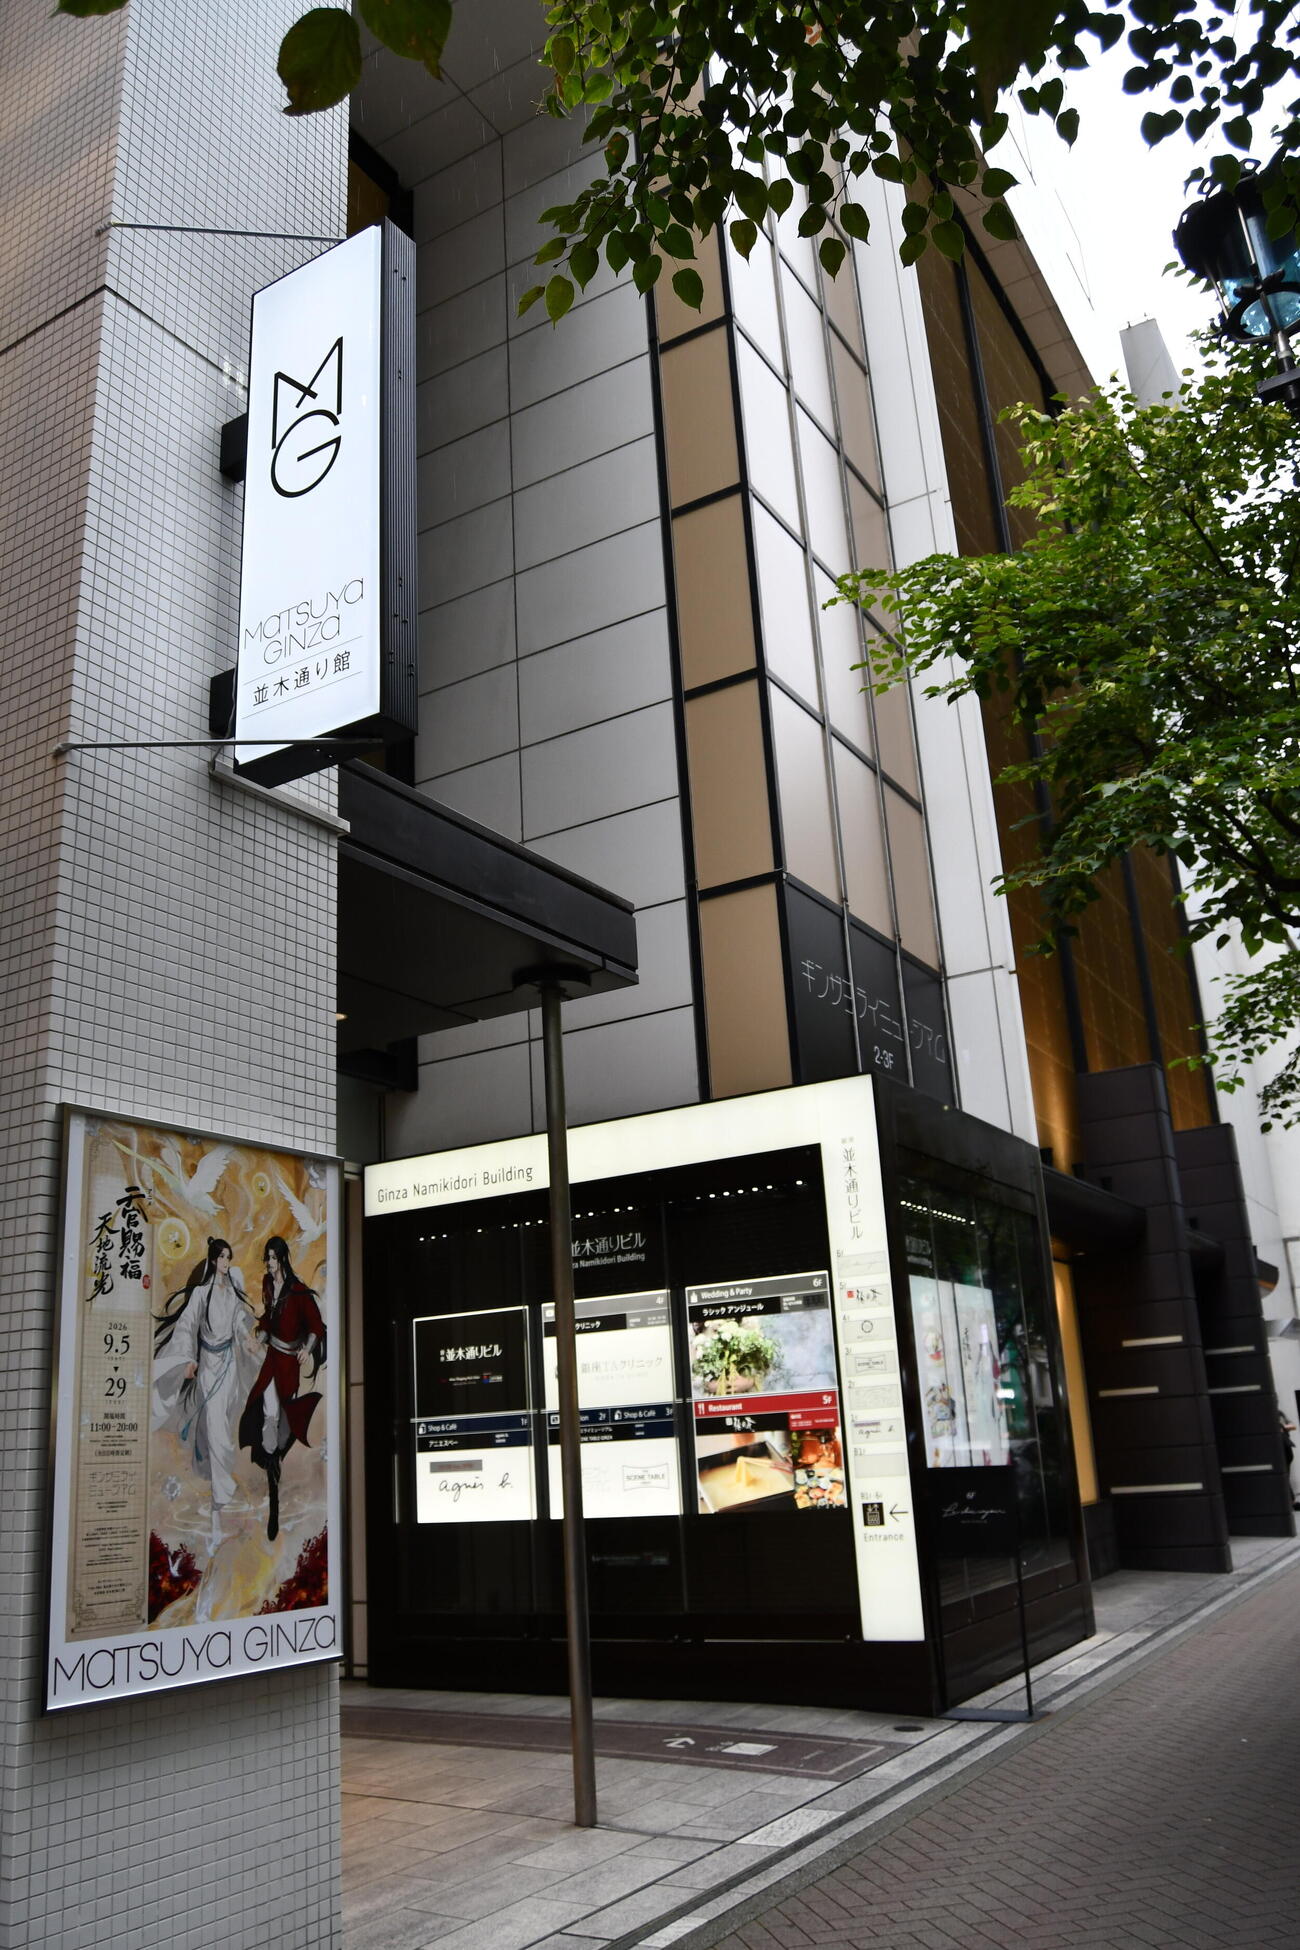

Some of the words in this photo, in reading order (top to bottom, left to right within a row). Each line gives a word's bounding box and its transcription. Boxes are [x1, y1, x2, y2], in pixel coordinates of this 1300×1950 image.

[253, 650, 351, 707] 並木通り館
[377, 1187, 408, 1203] Ginza
[413, 1173, 477, 1197] Namikidori
[483, 1166, 533, 1186] Building
[579, 1257, 616, 1269] Namikidori
[617, 1253, 645, 1265] Building
[701, 1290, 729, 1299] Wedding
[735, 1287, 753, 1296] Party
[104, 1333, 130, 1355] 9.5
[104, 1377, 127, 1398] 29
[708, 1402, 743, 1412] Restaurant
[624, 1412, 638, 1420] Shop
[428, 1424, 441, 1433] Shop
[864, 1533, 905, 1542] Entrance
